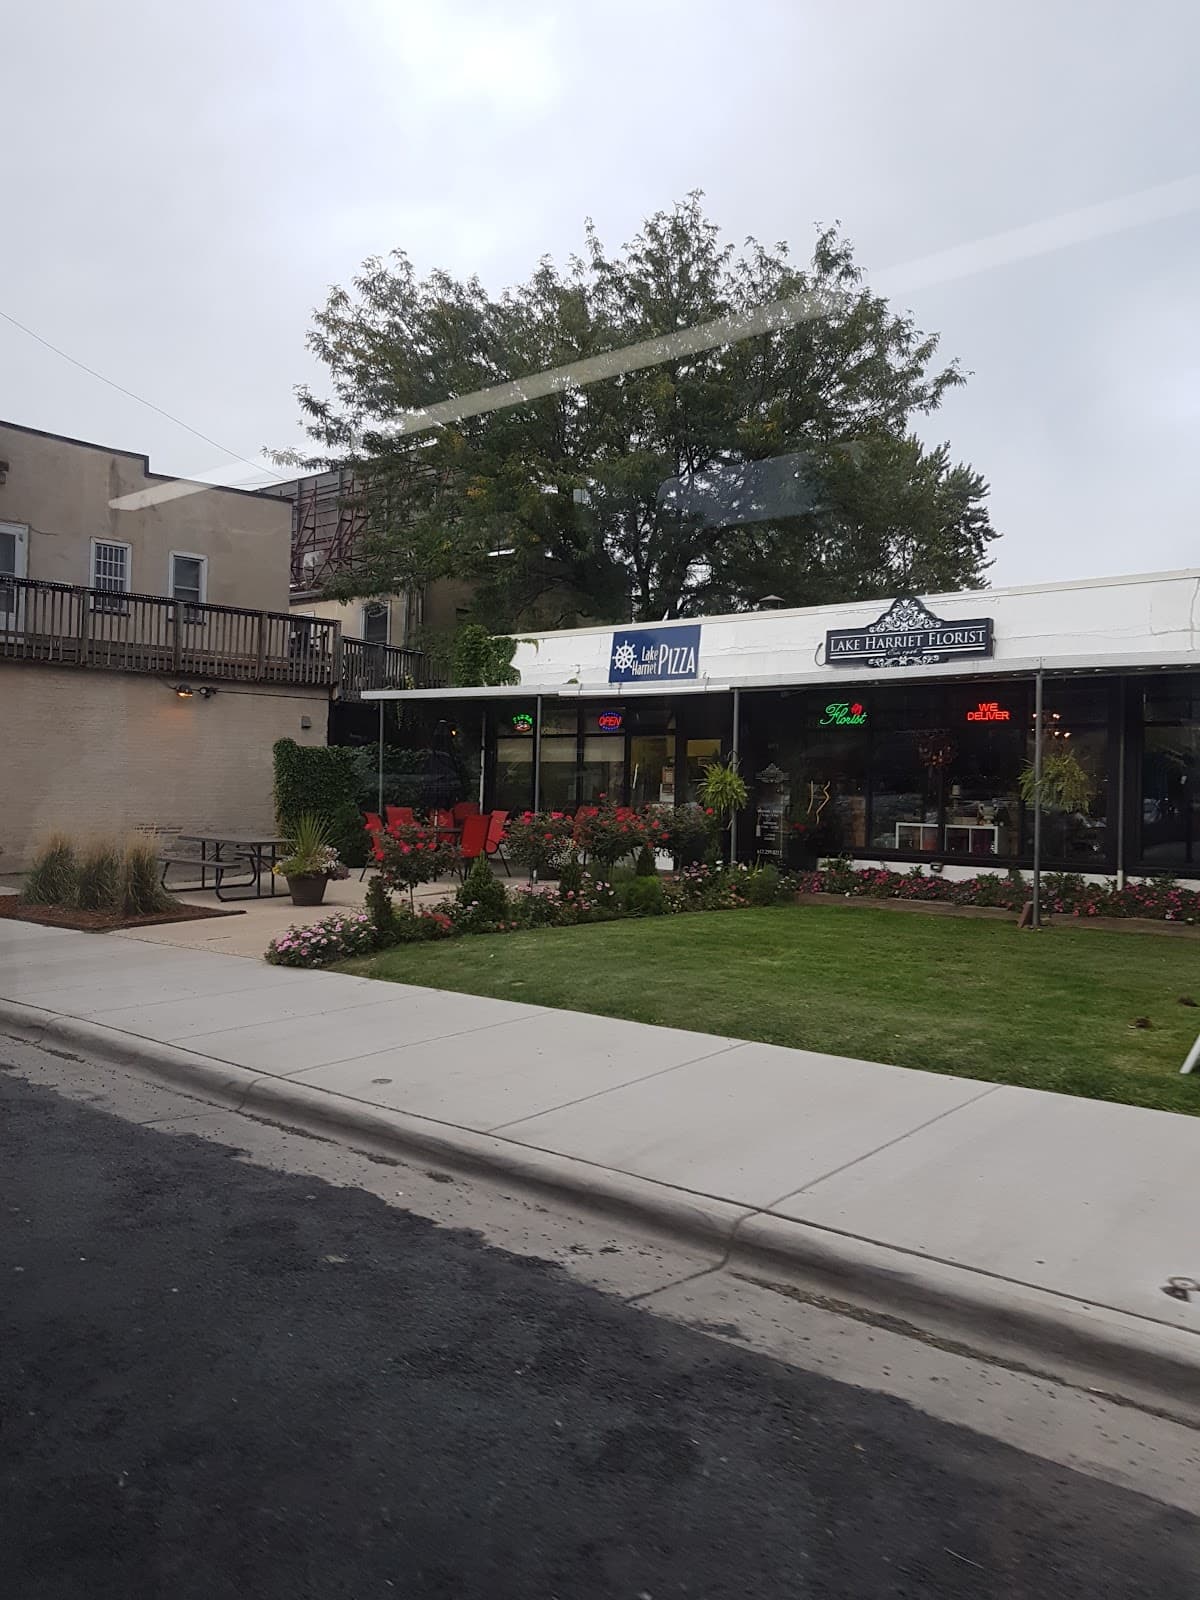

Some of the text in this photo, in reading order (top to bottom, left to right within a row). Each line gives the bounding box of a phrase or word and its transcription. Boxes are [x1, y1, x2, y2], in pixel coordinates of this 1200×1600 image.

[830, 630, 986, 652] LAKE HARRIET FLORIST
[641, 645, 659, 662] Lake
[658, 643, 695, 675] PIZZA
[631, 660, 657, 676] Harriet
[819, 702, 868, 725] Florist
[978, 702, 999, 712] WE
[599, 715, 622, 727] OPEN
[967, 711, 1010, 721] DELIVER
